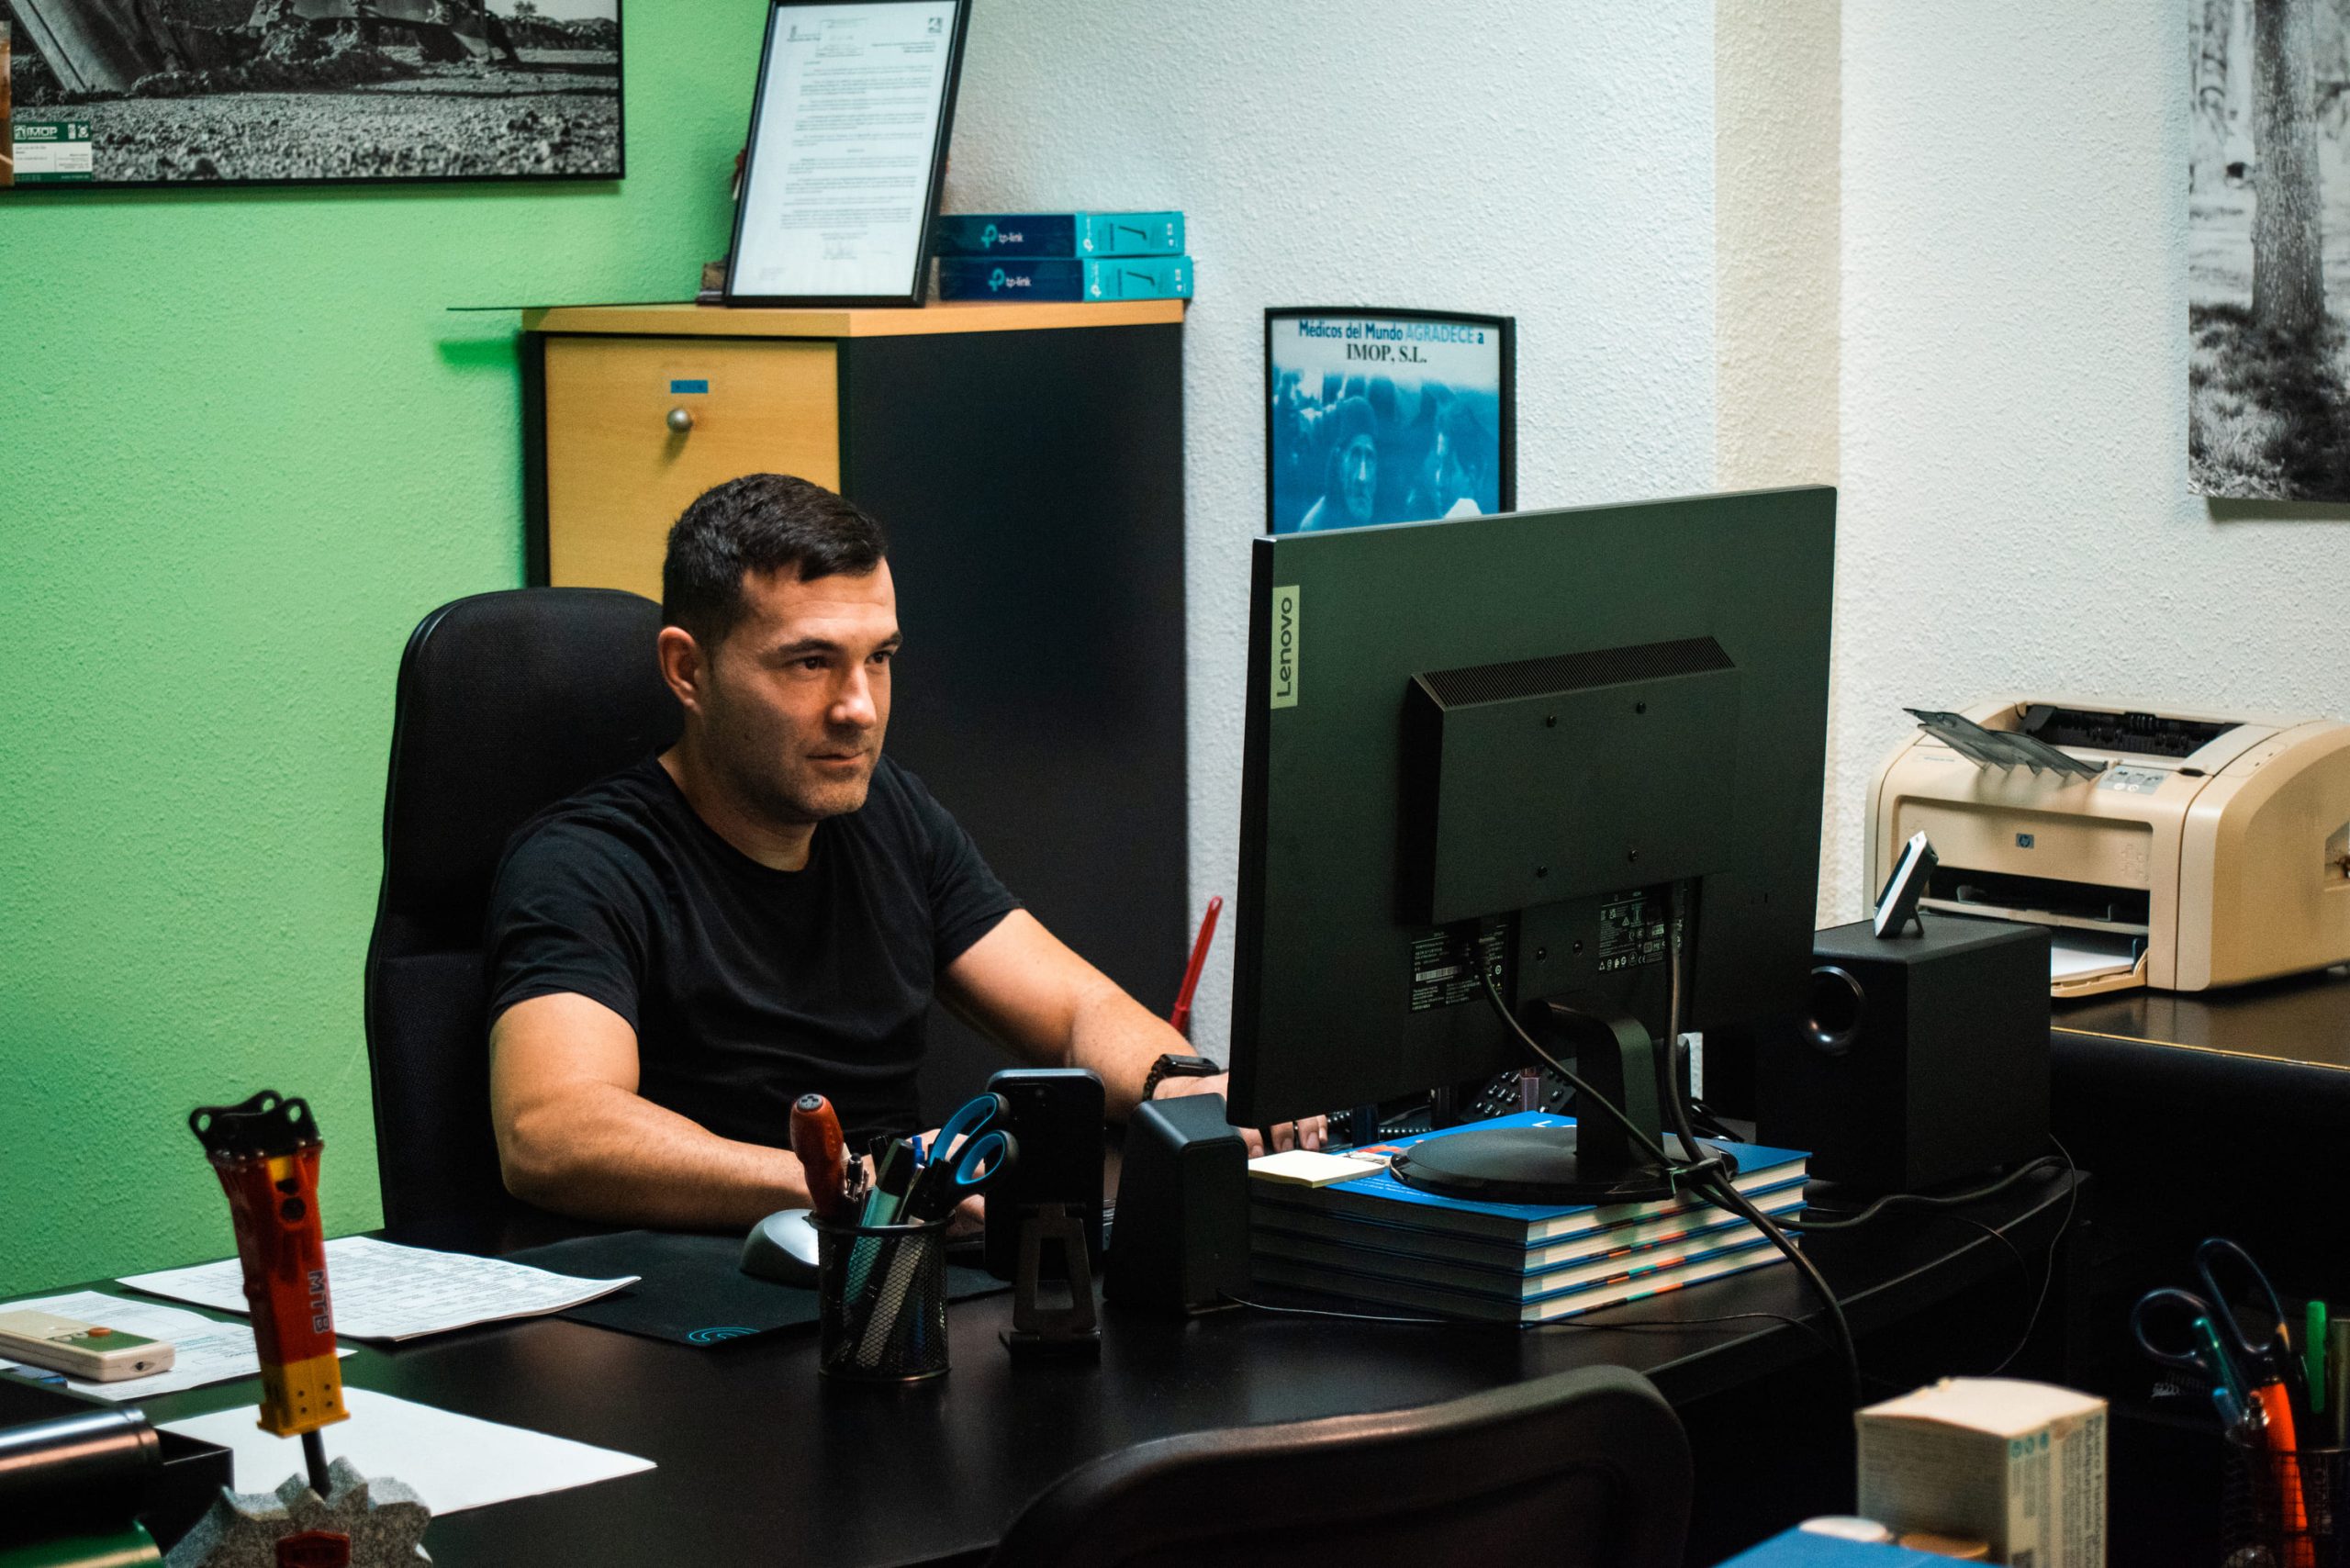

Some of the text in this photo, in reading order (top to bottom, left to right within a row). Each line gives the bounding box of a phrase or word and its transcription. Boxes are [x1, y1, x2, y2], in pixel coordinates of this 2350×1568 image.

[998, 231, 1024, 245] tp-link
[1005, 275, 1032, 289] tp-link
[1299, 319, 1484, 344] Médicos del Mundo AGRADECE a
[1347, 343, 1427, 364] IMOP, S.L.
[1277, 597, 1292, 697] Lenovo
[308, 1269, 330, 1335] MTB
